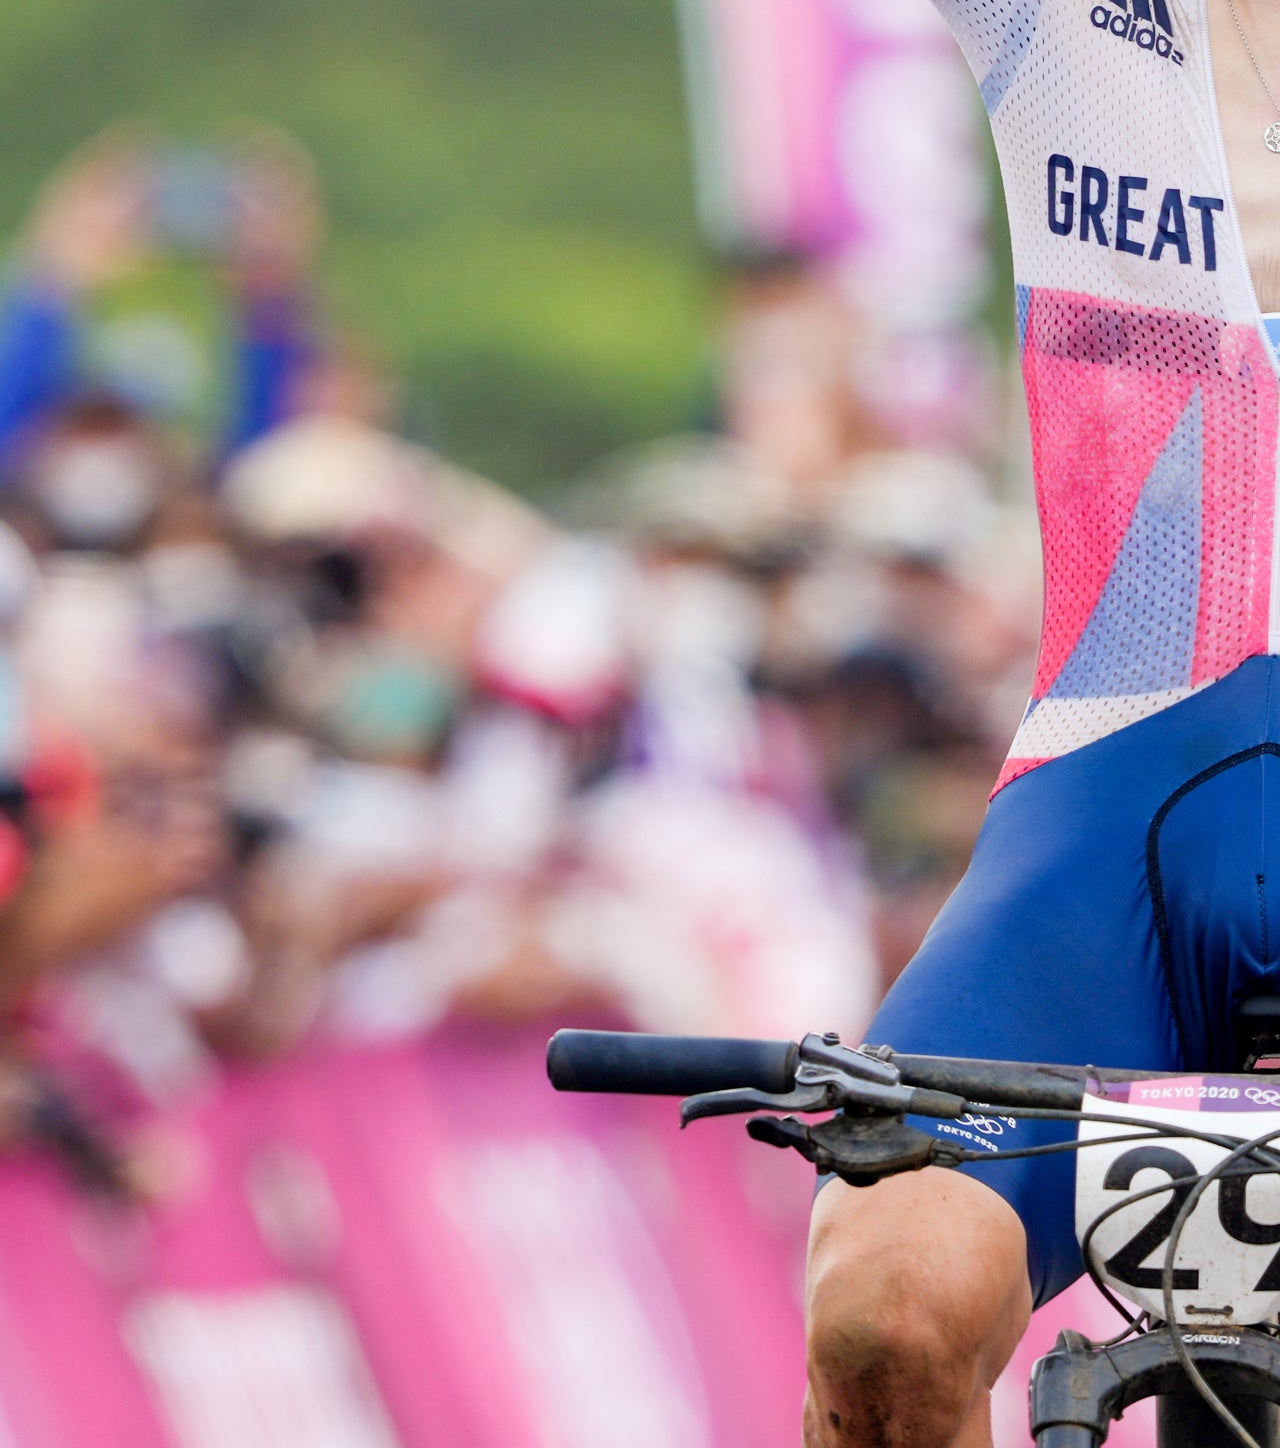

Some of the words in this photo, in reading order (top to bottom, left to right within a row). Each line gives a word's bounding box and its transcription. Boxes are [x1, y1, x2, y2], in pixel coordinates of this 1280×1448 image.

[1090, 5, 1184, 67] adidas
[1047, 153, 1224, 272] GREAT
[1140, 1086, 1195, 1099] TOKYO
[1197, 1086, 1239, 1099] 2020
[937, 1123, 972, 1139] TOKYO
[973, 1135, 998, 1152] 2020
[1181, 1334, 1240, 1345] CARBON
